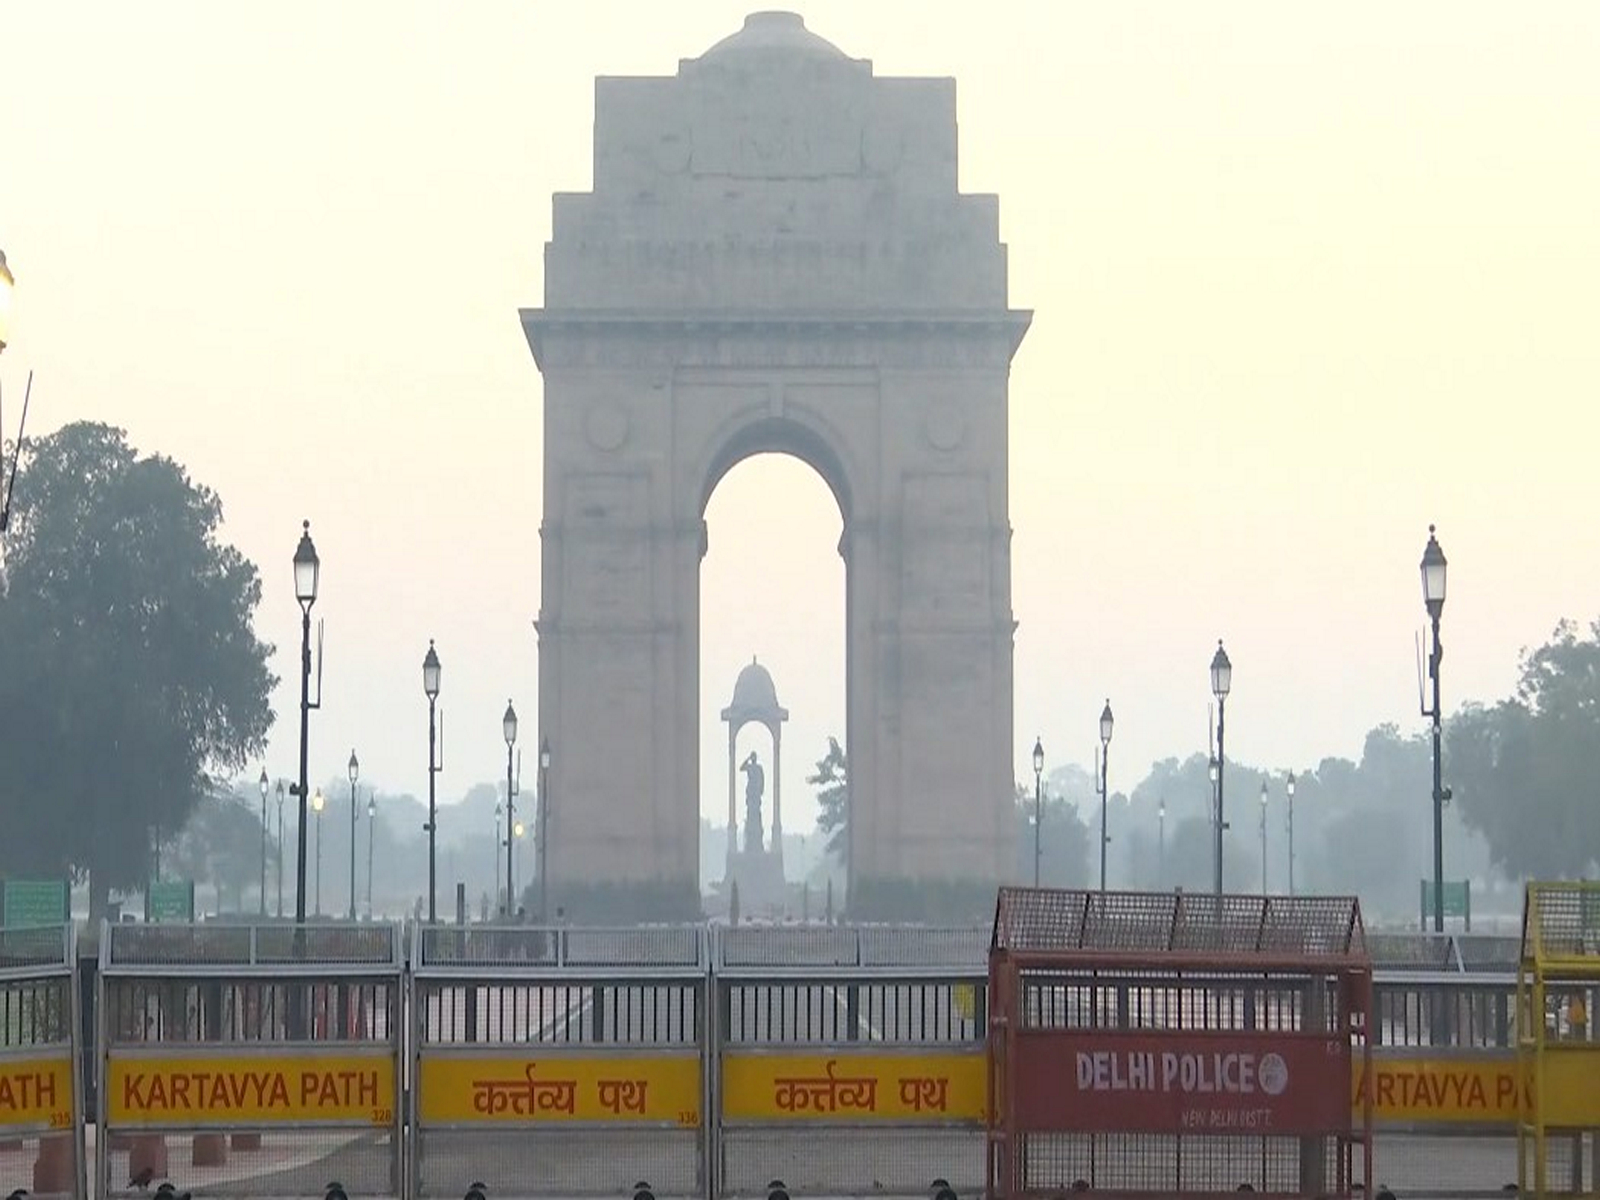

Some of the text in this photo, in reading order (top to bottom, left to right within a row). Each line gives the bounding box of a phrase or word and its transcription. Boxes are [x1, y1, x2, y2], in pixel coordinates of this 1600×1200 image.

[123, 1072, 378, 1110] KARTAVYA PATH
[472, 1063, 648, 1115] कर्त्तव्य पथ
[774, 1060, 948, 1112] कर्त्तव्य पथ
[1076, 1052, 1255, 1093] DELHI POLICE
[1496, 1073, 1535, 1109] PA
